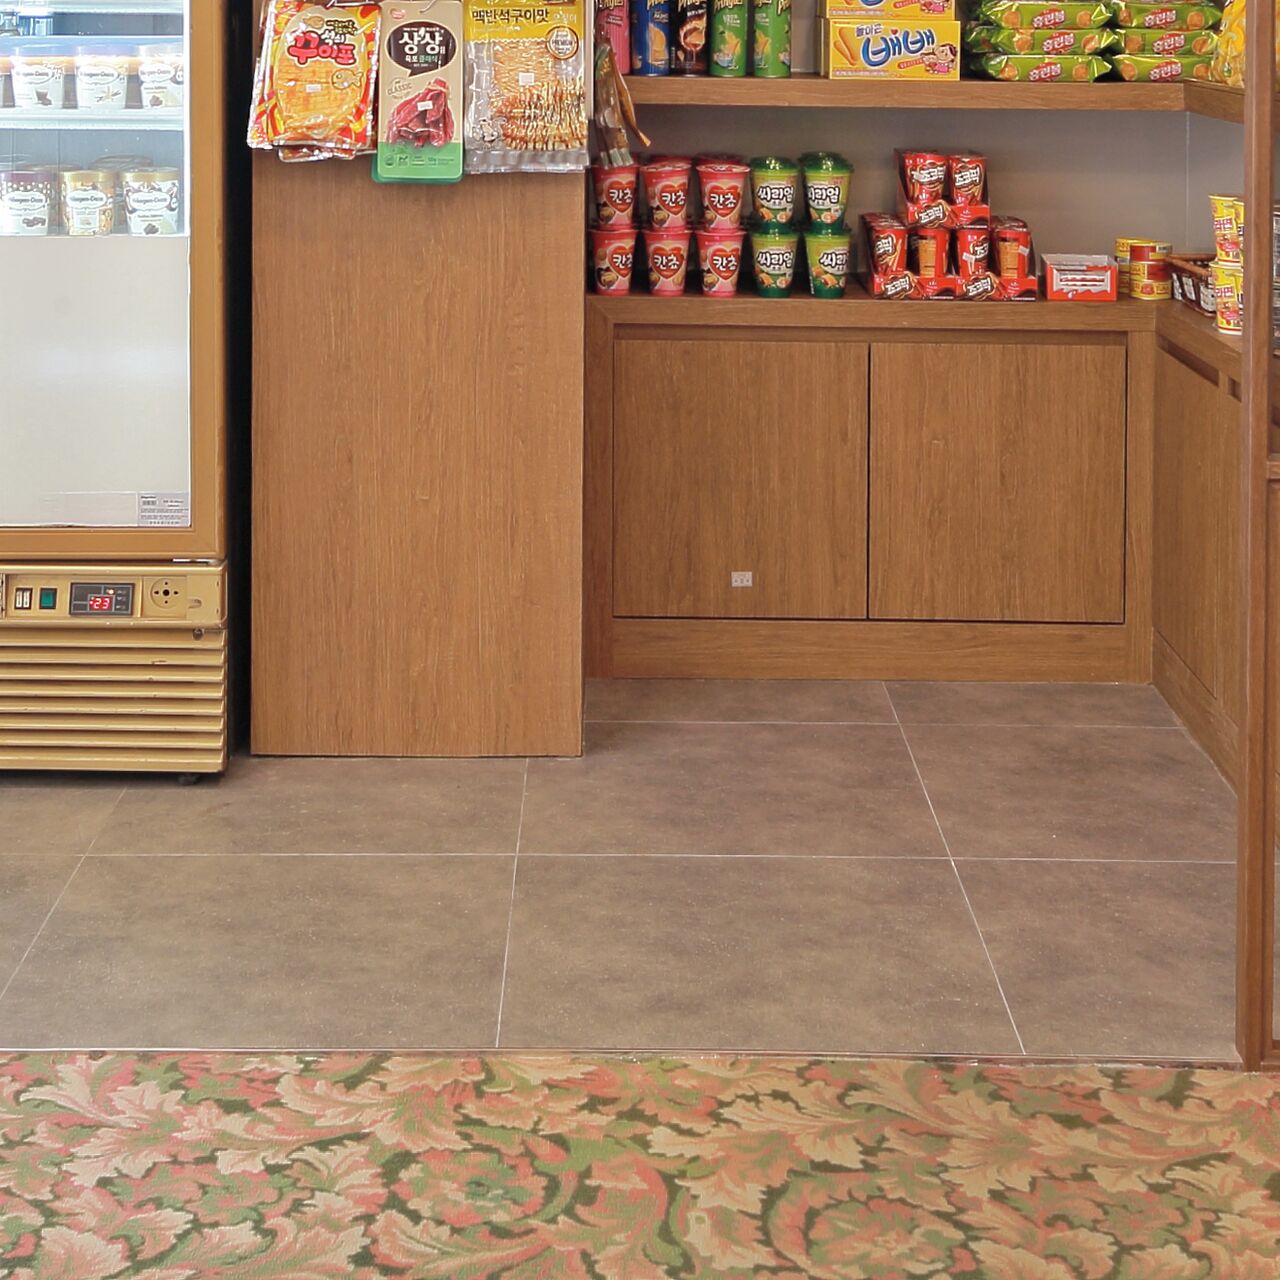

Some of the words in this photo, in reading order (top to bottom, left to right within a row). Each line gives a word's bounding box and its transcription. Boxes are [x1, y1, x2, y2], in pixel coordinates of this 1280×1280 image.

[472, 8, 549, 24] 맥반석구이맛
[287, 30, 356, 66] 꾸이포
[398, 30, 443, 55] 상상
